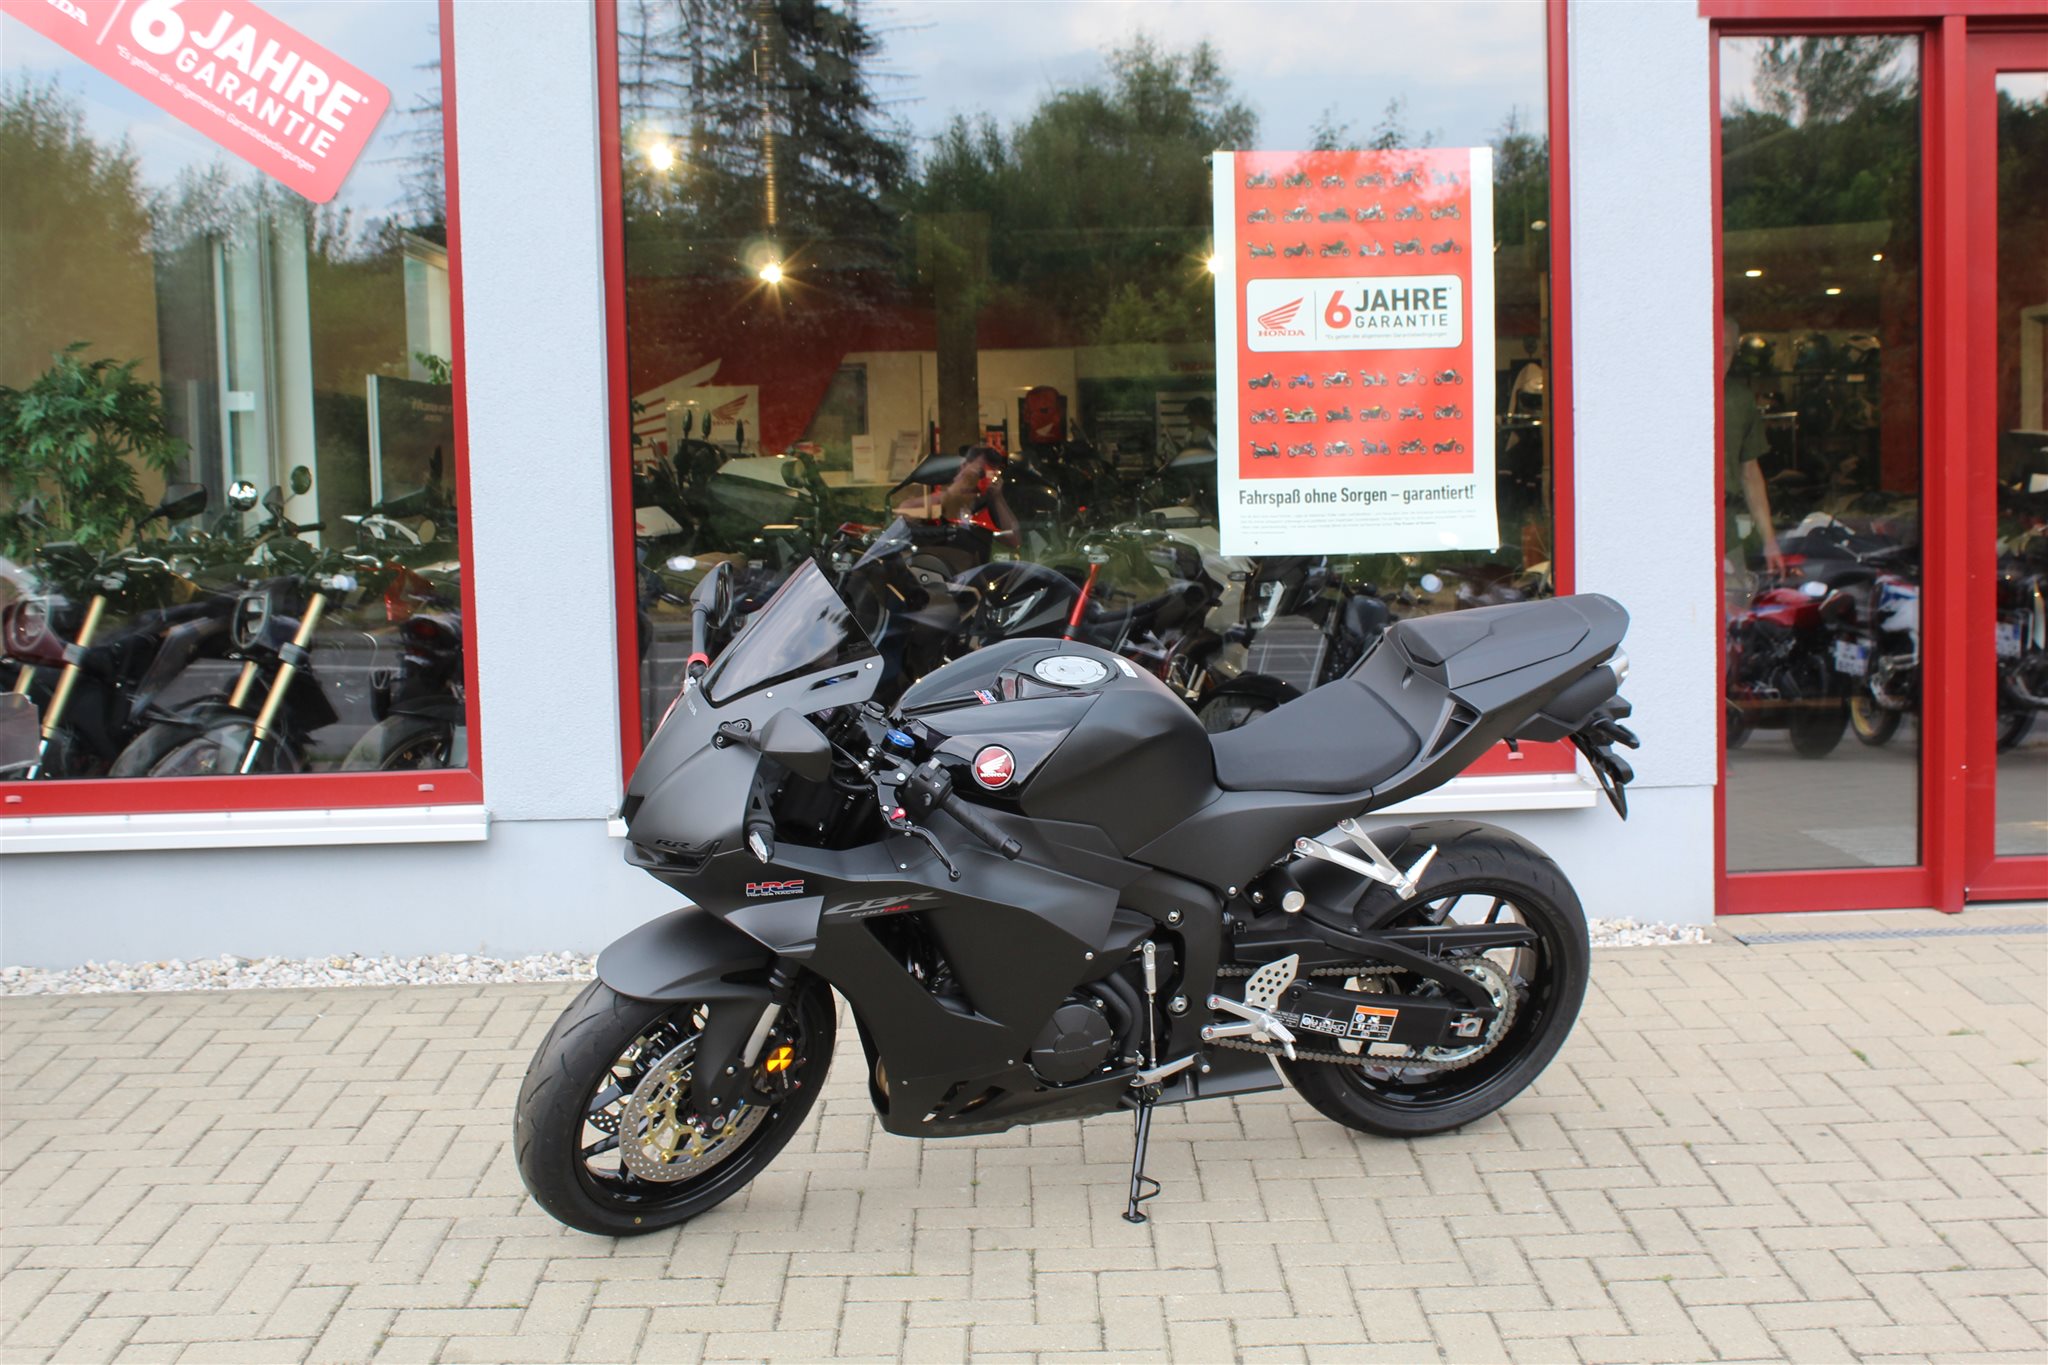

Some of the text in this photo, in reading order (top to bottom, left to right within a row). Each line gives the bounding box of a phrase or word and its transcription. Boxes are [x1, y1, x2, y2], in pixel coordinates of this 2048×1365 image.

[130, 0, 188, 55] 6
[176, 47, 336, 158] GARANTIE
[1324, 290, 1352, 329] 6
[1355, 313, 1448, 329] GARANTIE
[1239, 489, 1301, 508] Fahrspaß
[1304, 488, 1337, 504] ohne
[1341, 487, 1387, 505] Sorgen
[1403, 484, 1474, 504] garantiert!
[746, 880, 804, 895] HRC
[823, 892, 943, 915] CBR
